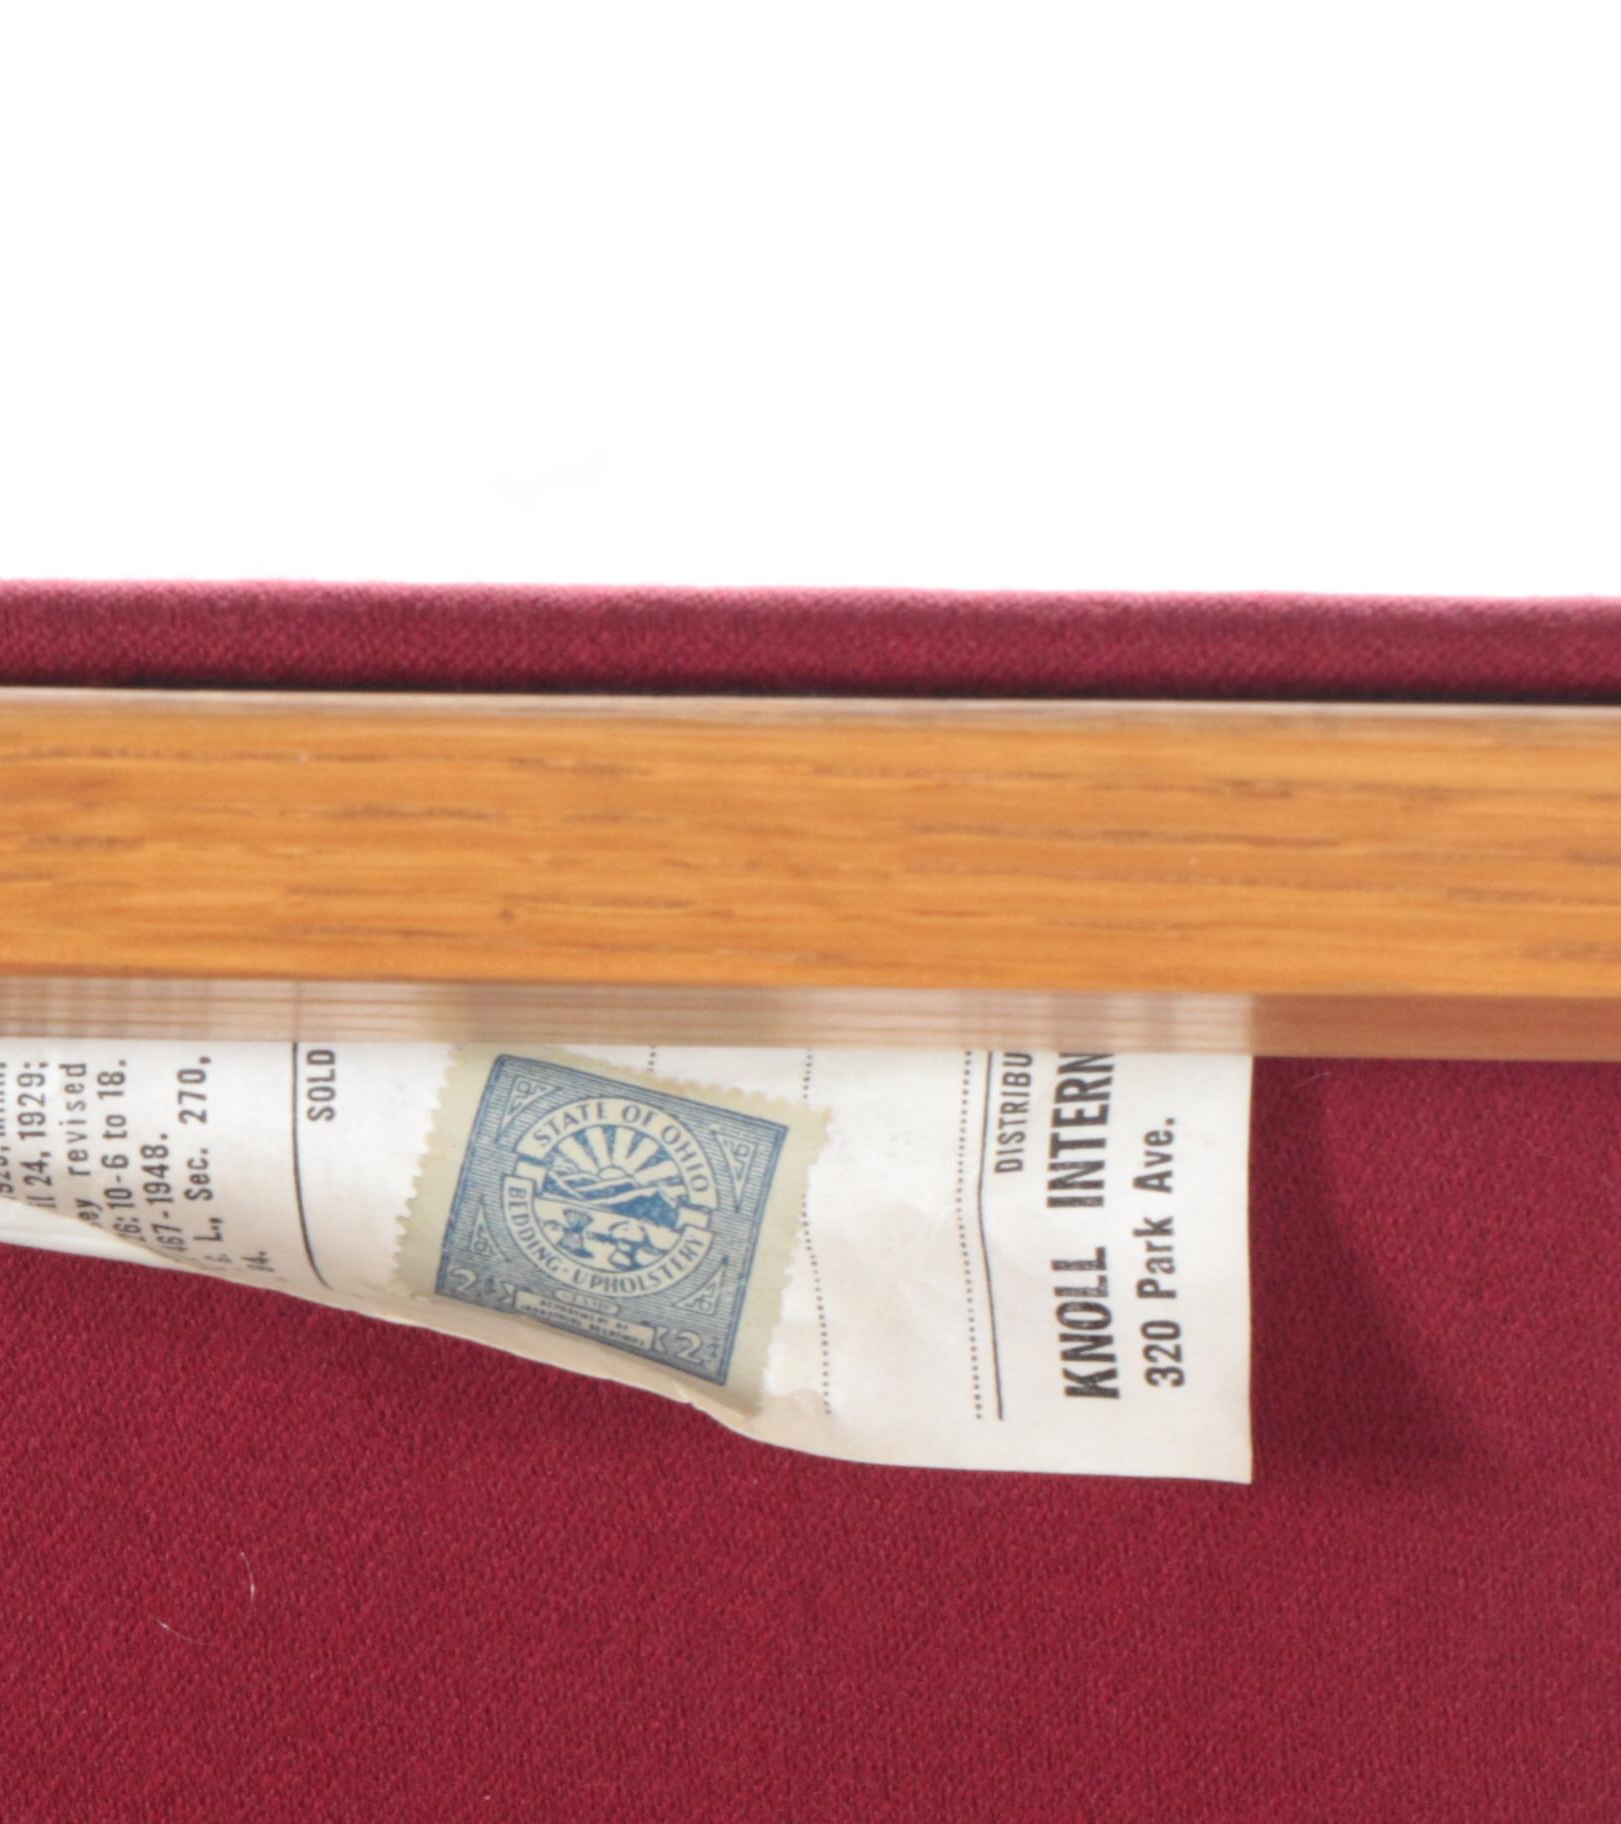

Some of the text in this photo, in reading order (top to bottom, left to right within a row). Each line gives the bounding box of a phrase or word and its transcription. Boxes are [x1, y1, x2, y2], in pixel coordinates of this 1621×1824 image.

[16, 1061, 49, 1142] 1929;
[96, 1058, 128, 1101] 18.
[176, 1056, 212, 1126] 270,
[306, 1048, 337, 1123] SOLD
[58, 1062, 92, 1177] revised
[101, 1113, 129, 1142] to
[532, 1100, 709, 1195] STATE OF OHIO
[20, 1150, 55, 1187] 24,
[184, 1147, 214, 1202] Sec.
[507, 1185, 705, 1293] BEDDING UPHOLSTERY
[1131, 1116, 1186, 1388] 320 Park Ave.
[1050, 1245, 1121, 1400] KNOLL
